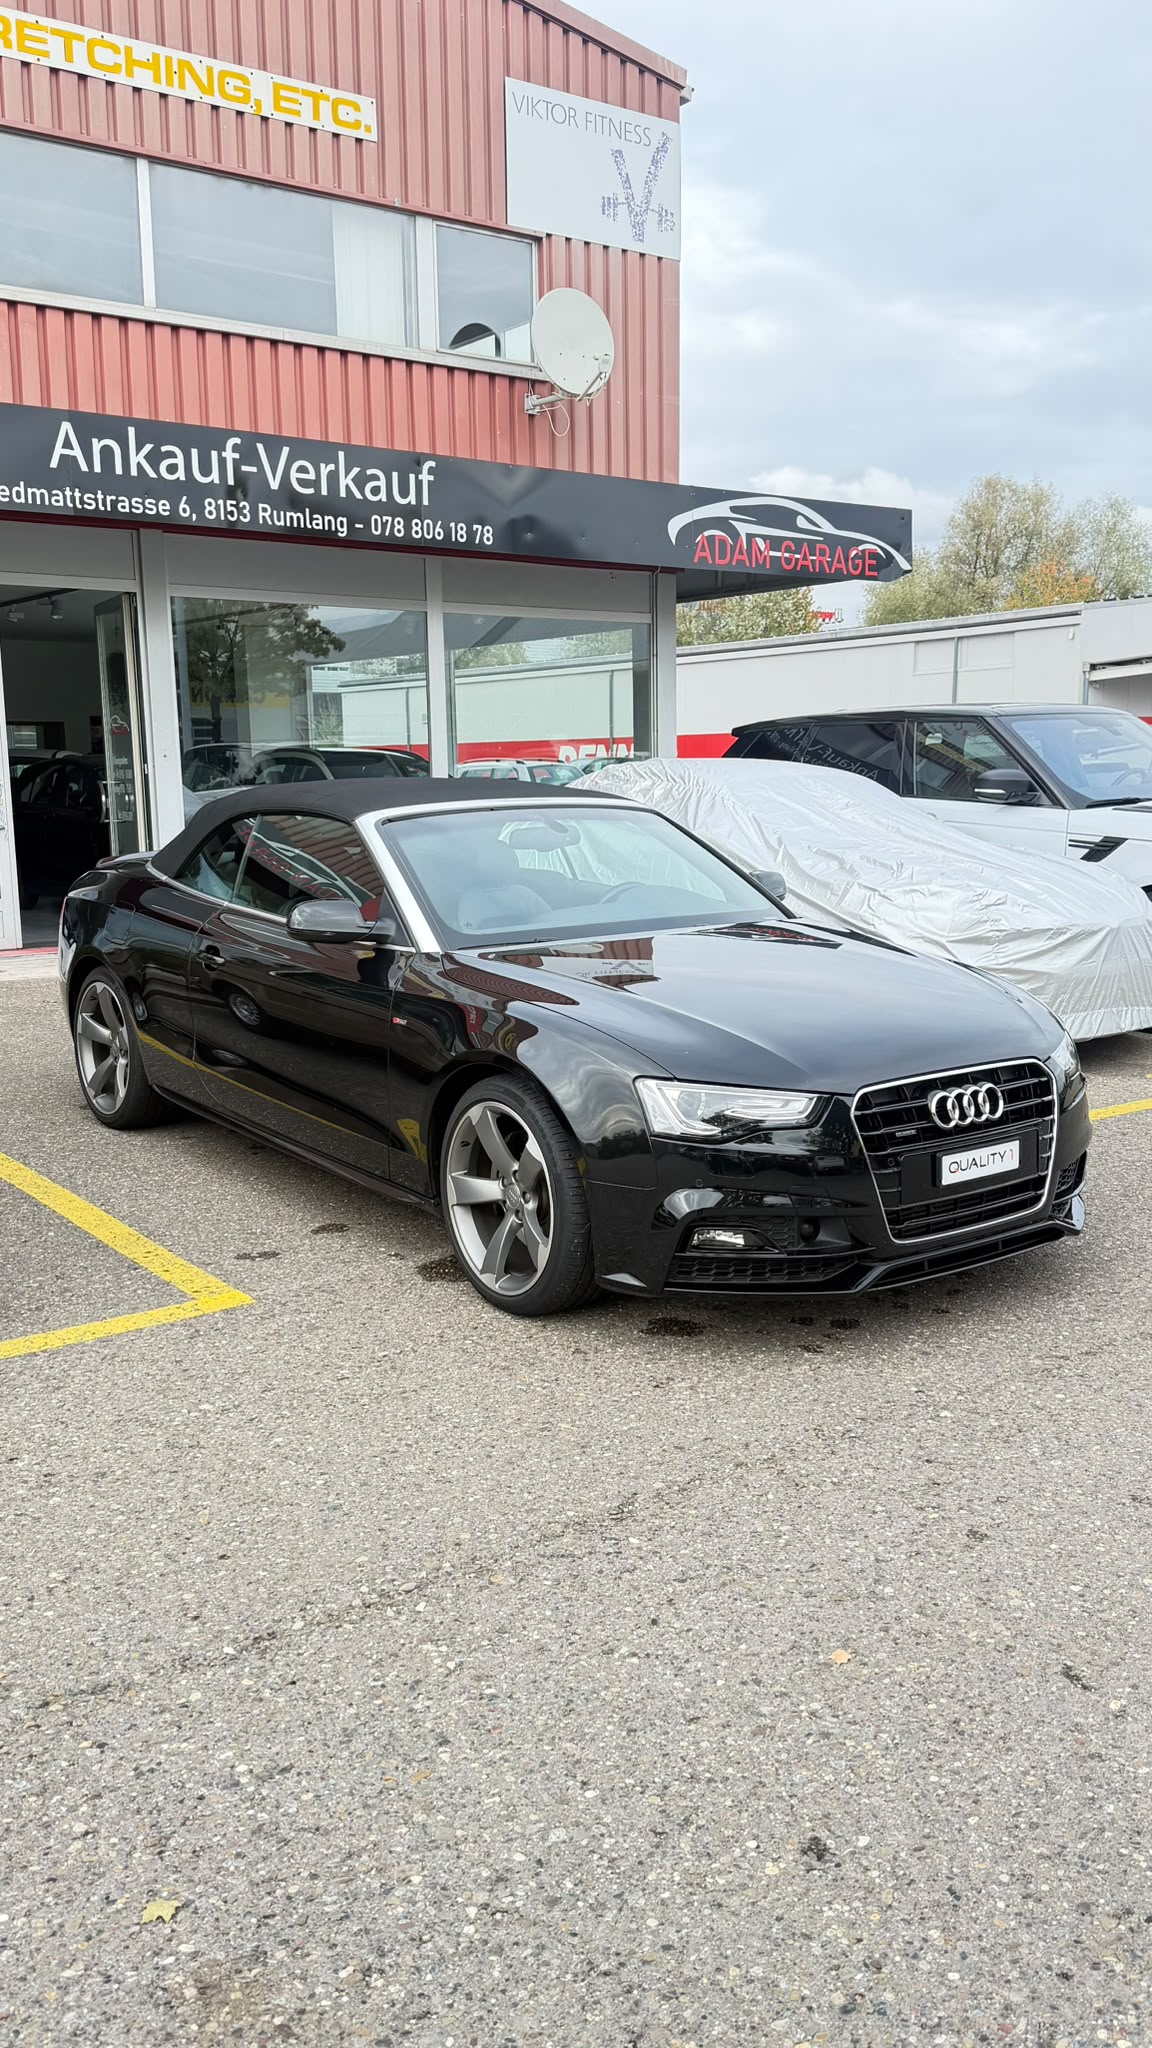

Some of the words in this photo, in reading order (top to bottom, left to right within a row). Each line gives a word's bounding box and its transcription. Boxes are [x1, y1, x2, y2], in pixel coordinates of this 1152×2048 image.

[272, 81, 372, 134] ETC.
[512, 91, 579, 128] VIKTOR
[585, 111, 652, 147] FITNESS
[49, 420, 436, 506] Ankauf-Verkauf
[0, 481, 171, 516] edmattstrasse
[178, 495, 197, 522] 6,
[204, 498, 250, 523] 8153
[258, 503, 347, 537] Rumlang
[370, 515, 405, 537] 078
[411, 519, 445, 540] 806
[449, 521, 467, 543] 18
[472, 524, 494, 546] 78
[693, 532, 771, 569] ADAM
[781, 541, 879, 577] GARAGE
